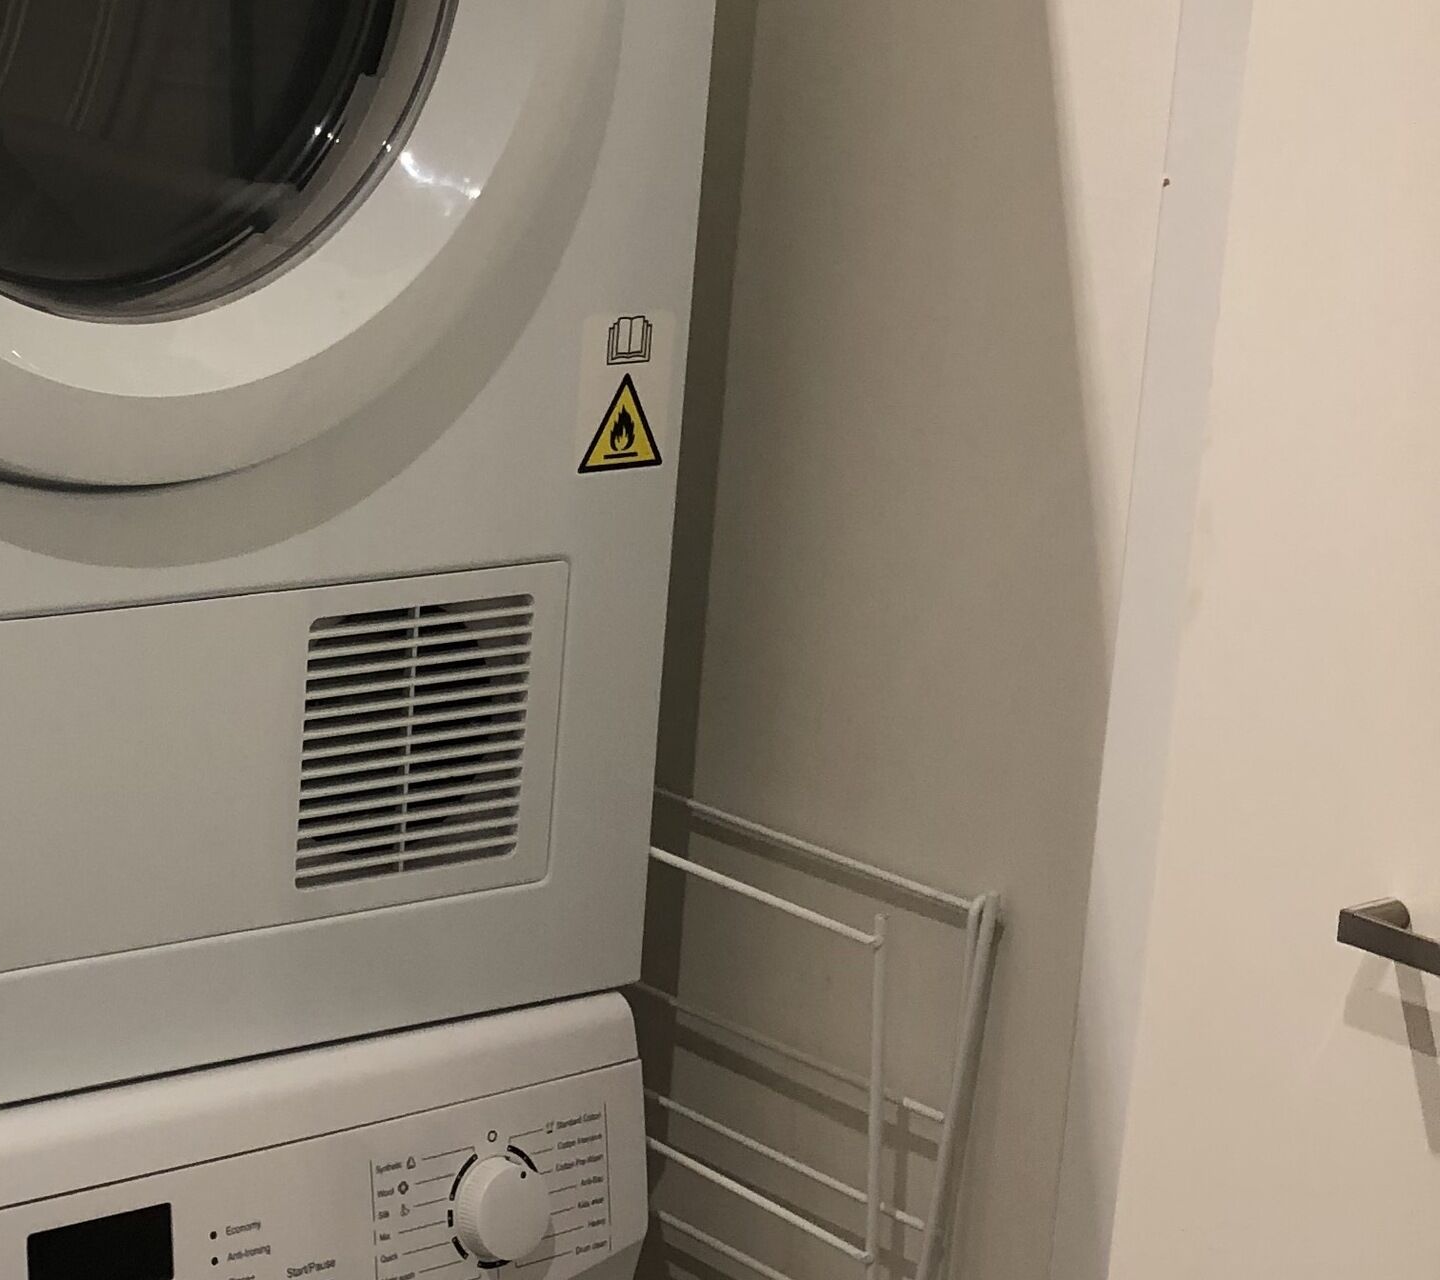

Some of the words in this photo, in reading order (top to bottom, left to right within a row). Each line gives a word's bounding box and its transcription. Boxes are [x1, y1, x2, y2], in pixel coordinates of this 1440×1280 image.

[377, 1187, 394, 1197] Wool
[225, 1221, 261, 1237] Economy
[227, 1244, 271, 1262] Anti-ironing
[380, 1253, 398, 1263] Quick
[286, 1257, 336, 1280] Start/Pause
